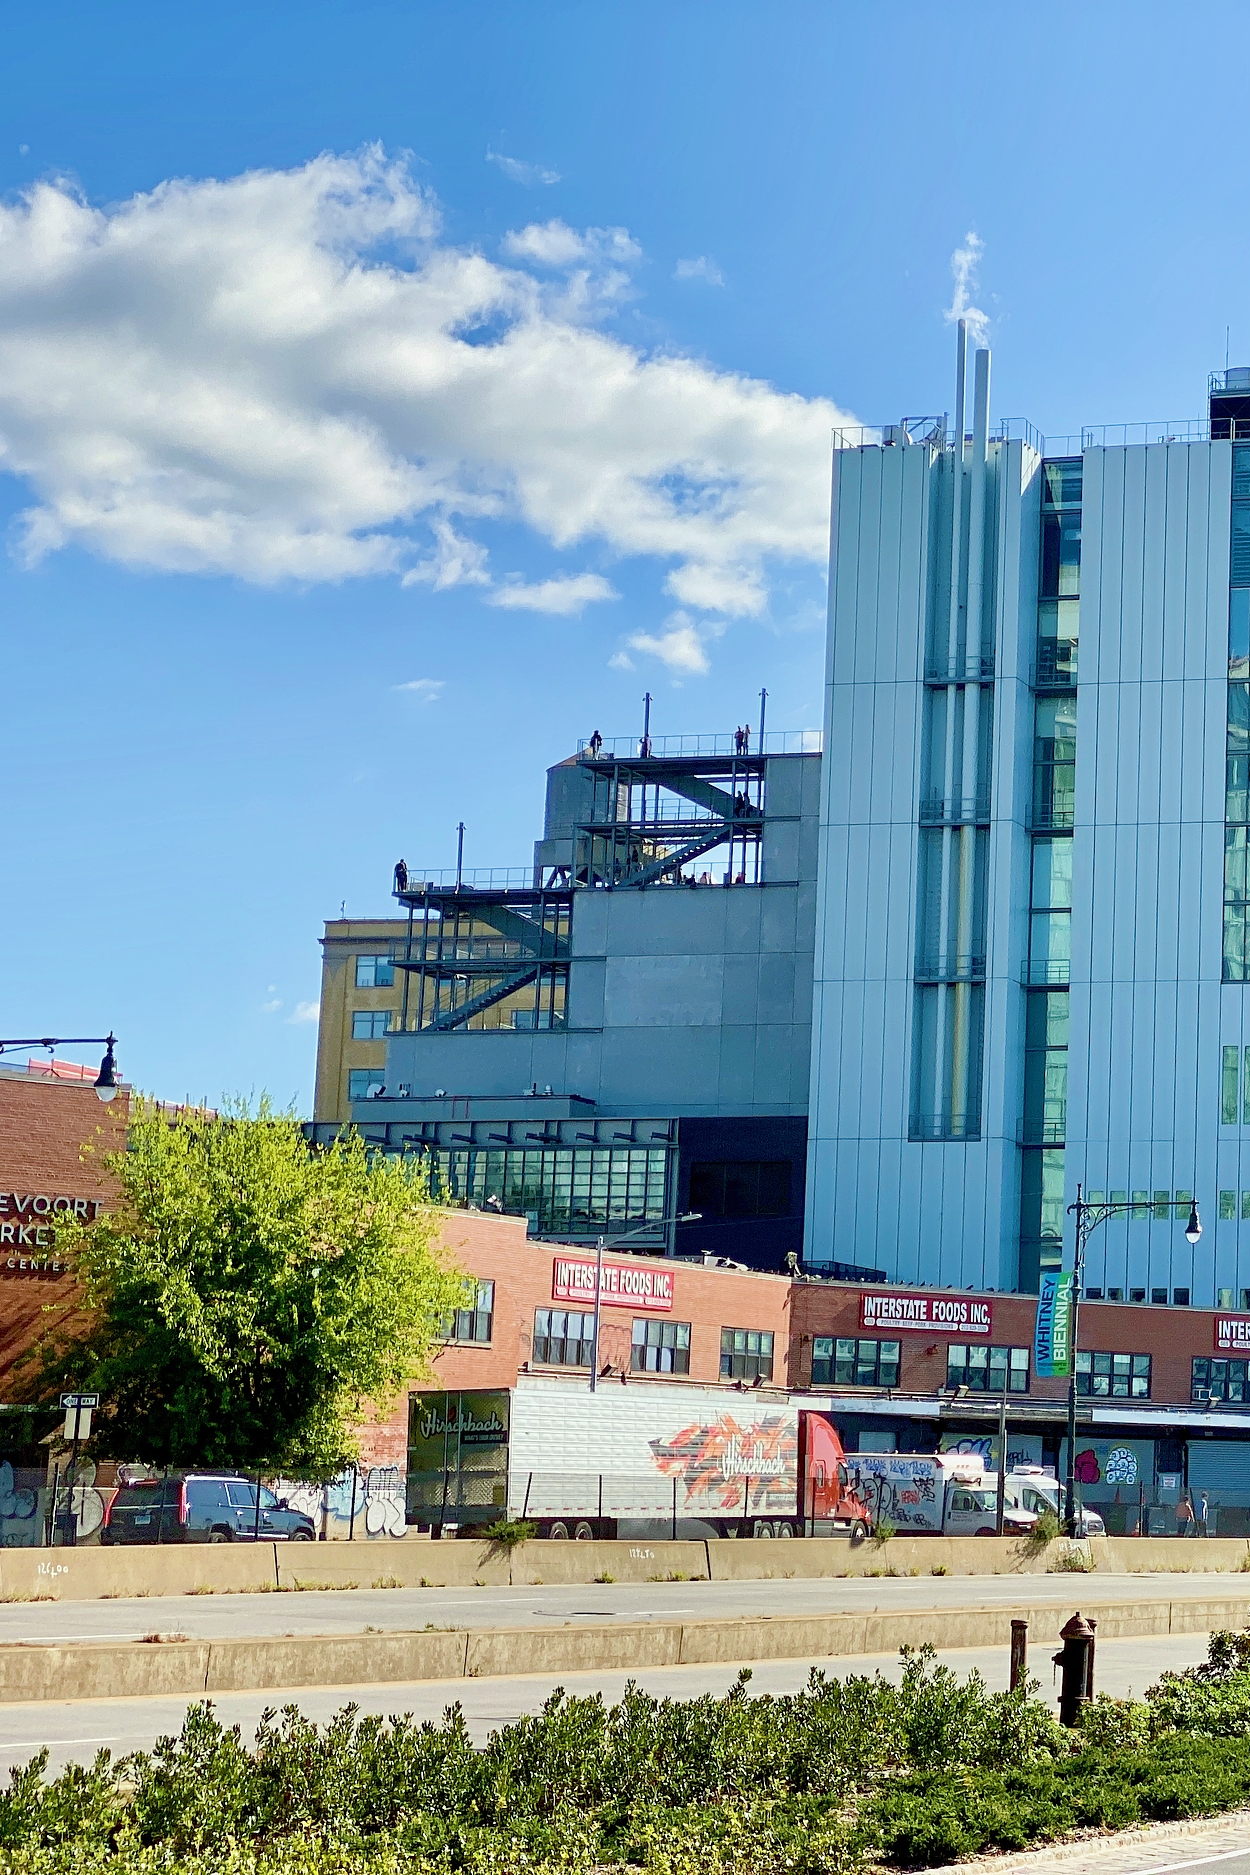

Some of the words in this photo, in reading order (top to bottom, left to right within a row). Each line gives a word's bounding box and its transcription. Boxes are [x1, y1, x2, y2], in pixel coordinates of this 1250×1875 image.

[620, 1270, 651, 1296] FOODS
[654, 1274, 672, 1298] INC.
[864, 1296, 927, 1320] INTERSTATE
[932, 1301, 967, 1323] FOODS
[970, 1304, 990, 1324] INC.
[1038, 1279, 1056, 1361] WHITNEY
[1053, 1277, 1071, 1361] BIENNIAL
